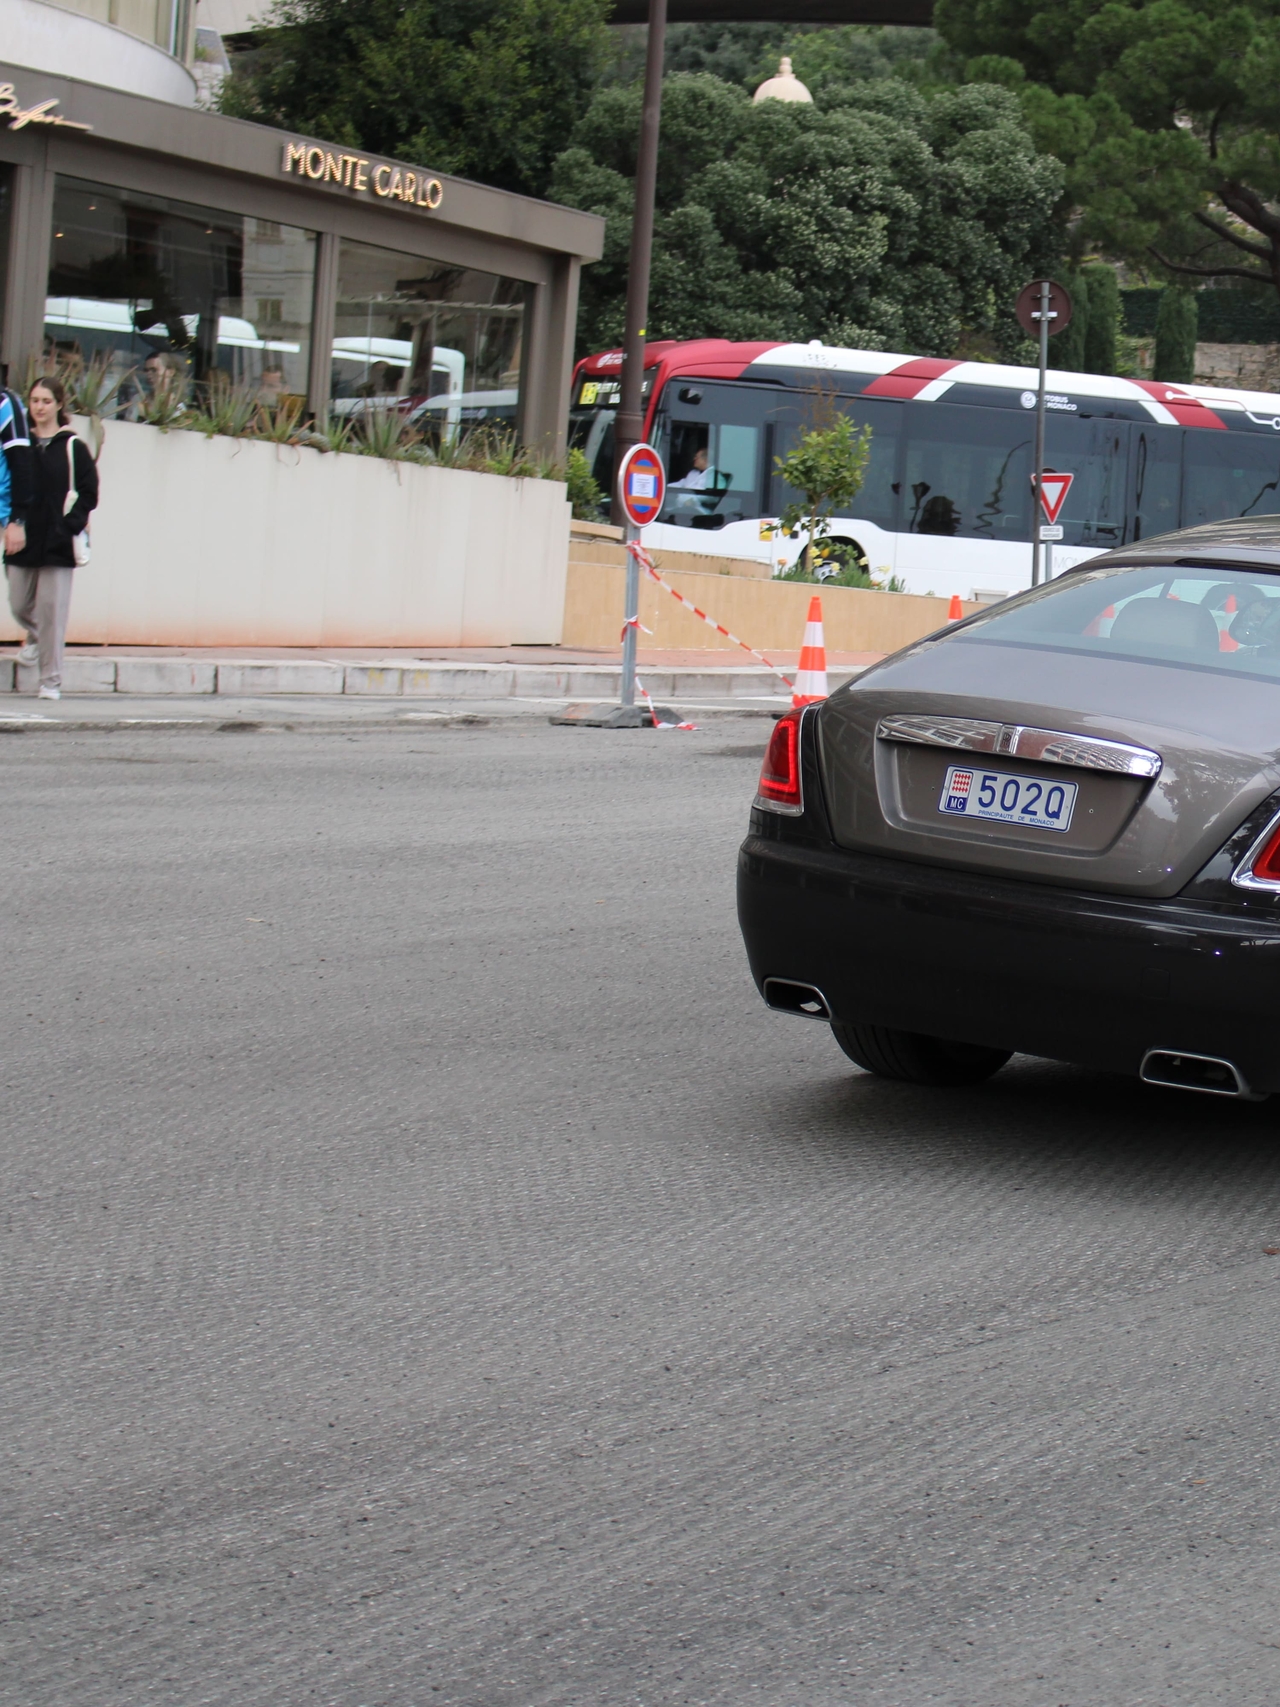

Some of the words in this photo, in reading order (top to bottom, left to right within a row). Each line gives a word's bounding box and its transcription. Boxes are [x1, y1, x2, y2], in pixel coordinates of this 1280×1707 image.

[282, 142, 369, 191] MONTE
[371, 164, 443, 209] CARLO
[950, 797, 964, 809] MC
[978, 774, 1066, 820] 502Q
[978, 809, 1014, 821] PRINCIPAUTE
[1029, 816, 1055, 827] MONACO
